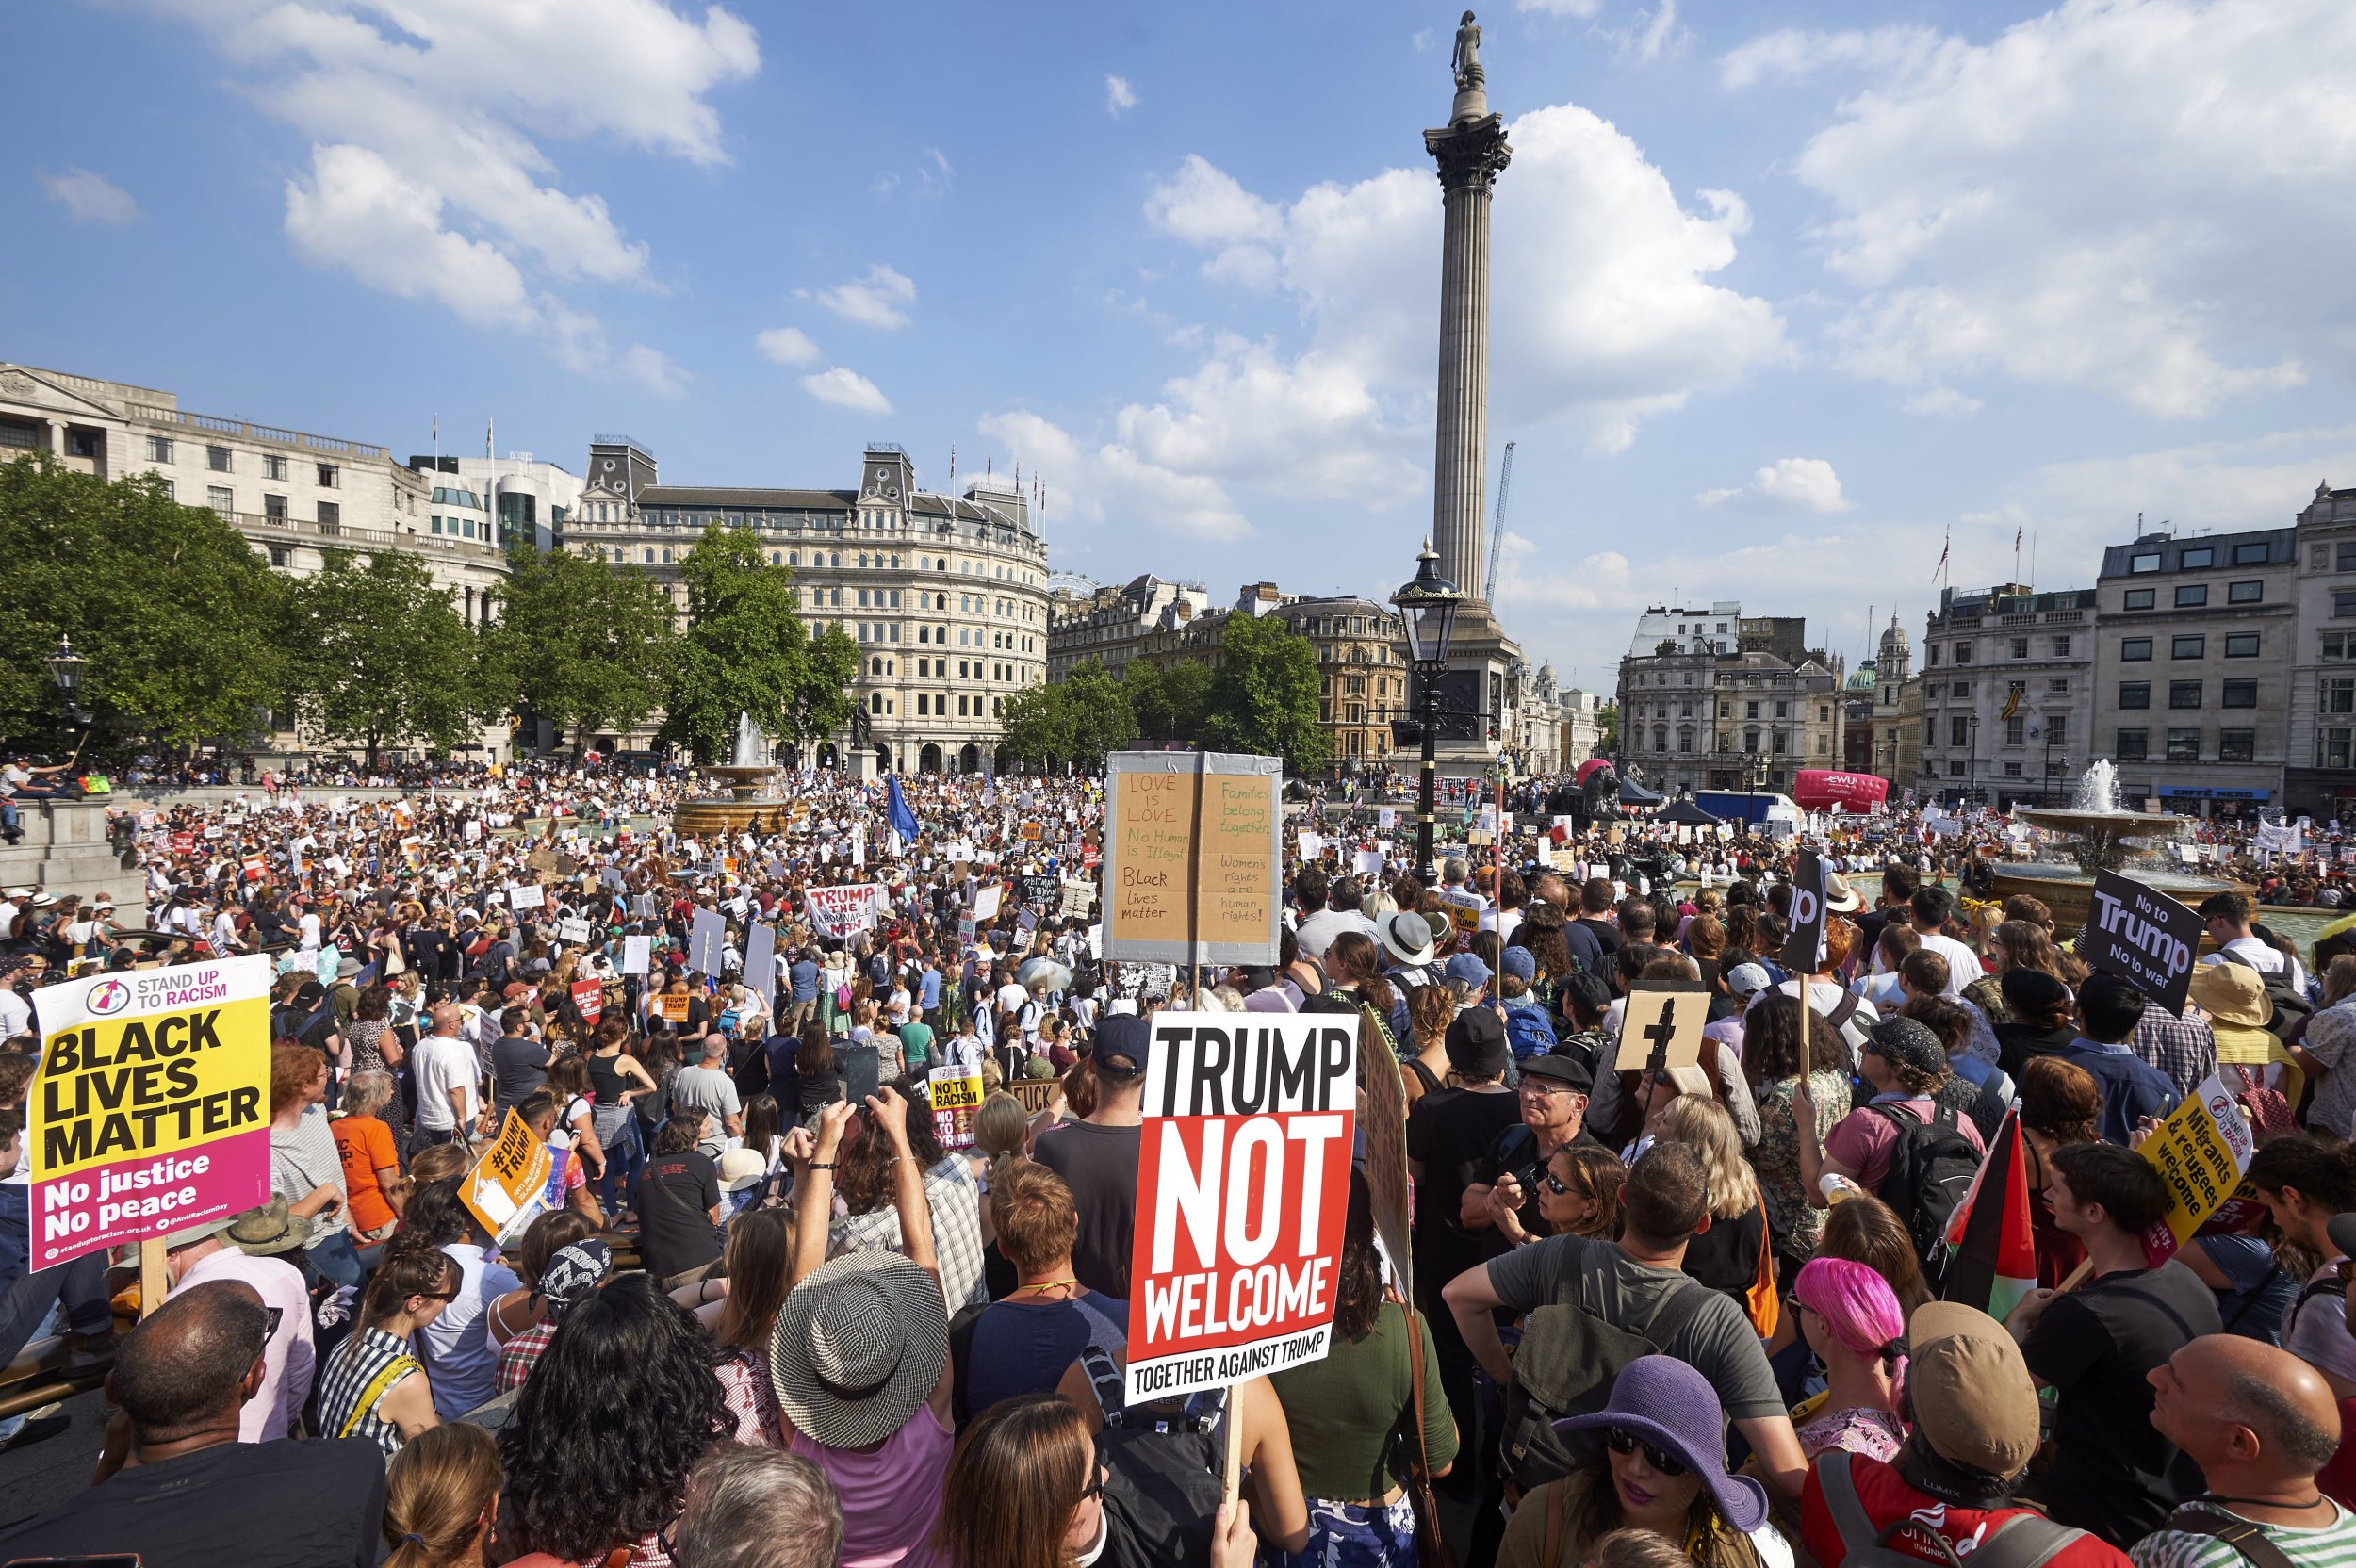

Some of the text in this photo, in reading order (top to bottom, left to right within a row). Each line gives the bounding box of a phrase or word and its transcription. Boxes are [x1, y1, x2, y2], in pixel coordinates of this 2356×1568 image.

[1130, 773, 1176, 793] LOVE
[1220, 781, 1270, 800] Families
[1145, 795, 1160, 807] IS
[1128, 808, 1177, 823] LOVE
[1222, 804, 1265, 824] belong
[1128, 828, 1188, 845] No Human
[1127, 844, 1185, 862] is Illegal
[1219, 854, 1267, 871] Women's
[1023, 877, 1055, 890] SHITMAN
[1224, 869, 1259, 886] rights
[813, 887, 875, 907] TRUMP
[1228, 884, 1252, 894] are
[829, 903, 858, 914] THE
[1219, 897, 1257, 910] human
[1455, 907, 1466, 919] NO
[2136, 894, 2168, 923] No to
[1121, 906, 1168, 922] matter
[1222, 906, 1263, 923] rights!
[1456, 917, 1476, 930] RUMP
[829, 919, 861, 937] MAN
[960, 932, 972, 943] YOU
[2094, 890, 2190, 979] Trump
[2110, 944, 2129, 964] No
[2132, 956, 2141, 972] to
[2145, 967, 2168, 988] war
[137, 970, 220, 995] STAND UP
[137, 984, 227, 1011] TO RACISM
[575, 995, 599, 1005] CARNIVAL
[664, 995, 688, 1004] #DUMP
[44, 1009, 222, 1077] BLACK
[1156, 1027, 1351, 1119] TRUMP
[43, 1058, 198, 1124] LIVES
[935, 1081, 968, 1095] NO TO
[936, 1092, 977, 1107] RACISM
[1013, 1085, 1053, 1112] FUCK
[937, 1111, 954, 1123] NO
[43, 1086, 260, 1170] MATTER
[939, 1121, 954, 1135] TO
[492, 1115, 521, 1169] #DUMP
[2186, 1106, 2231, 1185] Migrants
[2223, 1129, 2243, 1160] RACISM
[2239, 1135, 2249, 1149] UP
[500, 1130, 531, 1180] TRUMP
[2168, 1120, 2218, 1209] & refugees
[44, 1154, 210, 1213] No justice
[2156, 1141, 2201, 1217] welcome
[1151, 1114, 1344, 1276] NOT
[45, 1185, 197, 1242] No peace
[59, 1203, 228, 1254] standuptoracism.org.uk @AntiRacismDay
[1144, 1256, 1332, 1345] WELCOME
[1135, 1331, 1324, 1396] TOGETHER AGAINST TRUMP
[1923, 1478, 1961, 1498] LUMIX
